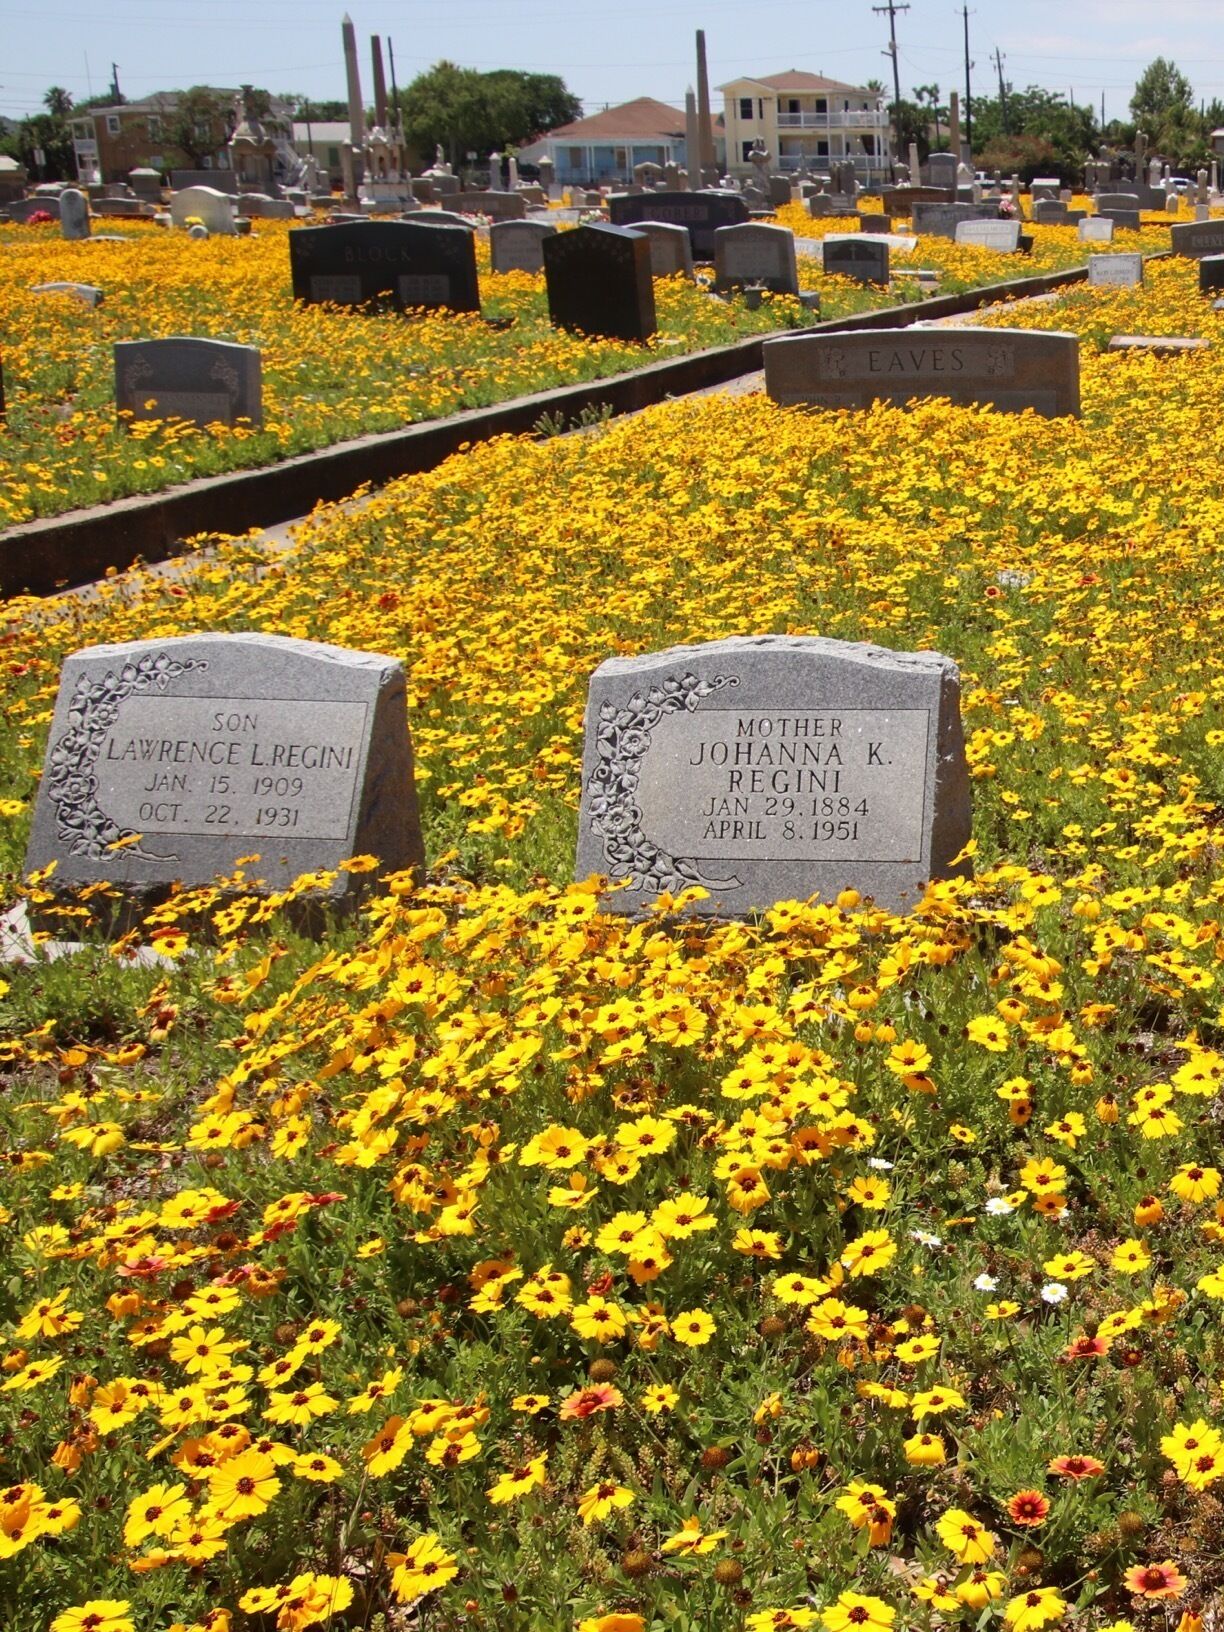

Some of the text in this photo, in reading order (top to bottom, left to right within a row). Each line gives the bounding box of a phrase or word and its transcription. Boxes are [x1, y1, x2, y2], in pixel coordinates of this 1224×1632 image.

[344, 245, 412, 262] BLOCK
[867, 349, 965, 373] EAVES
[212, 711, 259, 732] SON
[735, 717, 844, 738] MOTHER
[106, 737, 242, 766] LAWRENCE
[689, 741, 894, 767] JOHANNA K.
[144, 772, 193, 793] JAN.
[253, 776, 304, 797] 1909
[727, 769, 842, 794] REGINI
[138, 802, 189, 823] OCT.
[255, 806, 300, 827] 1931
[703, 796, 749, 817] JAN
[703, 820, 767, 840] APRIL
